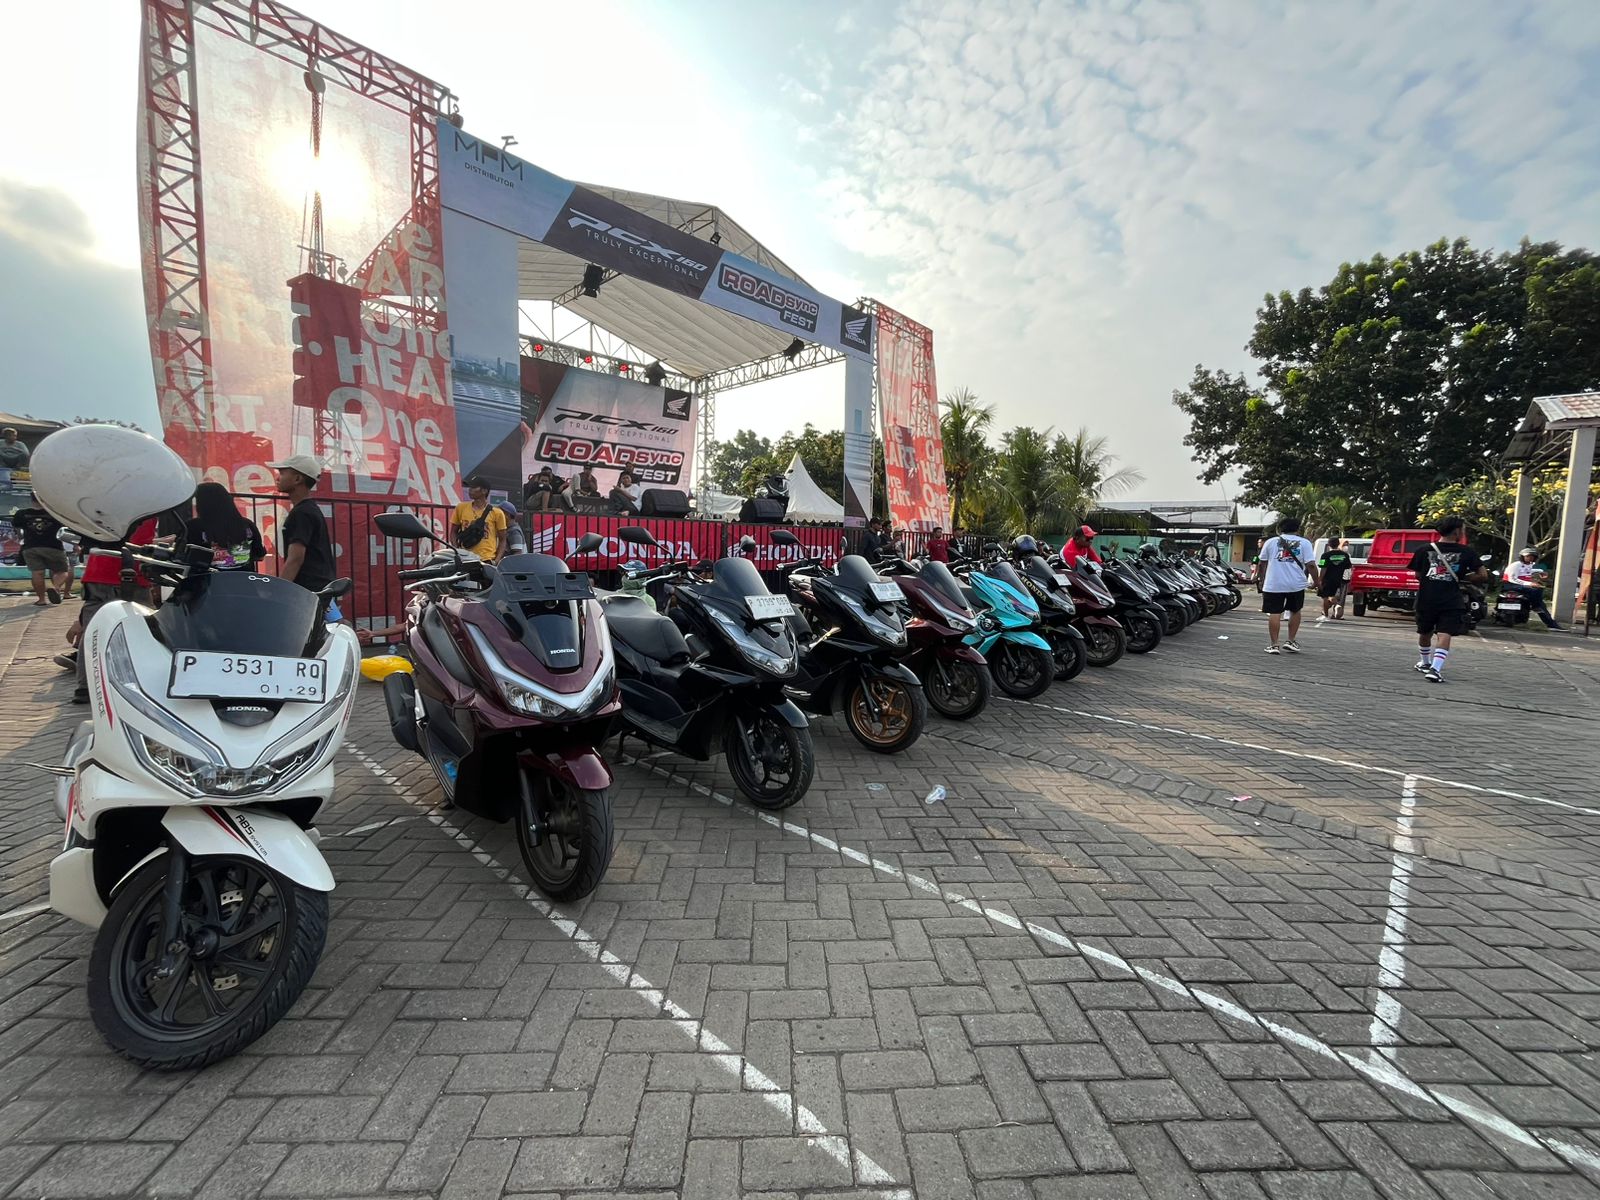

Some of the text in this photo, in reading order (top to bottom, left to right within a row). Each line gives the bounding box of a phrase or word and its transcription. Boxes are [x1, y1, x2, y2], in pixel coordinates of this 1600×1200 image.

[464, 162, 514, 188] DISTRIBUTOR
[585, 229, 699, 280] TRULY EXCEPTIONAL
[783, 311, 814, 329] FEST
[845, 334, 866, 346] HONDA
[327, 387, 443, 456] One
[666, 408, 686, 417] HONDA
[570, 421, 671, 443] TRULY EXCEPTIONAL
[1020, 576, 1047, 602] HONDA
[183, 655, 197, 672] P
[221, 657, 273, 676] 3531
[226, 705, 269, 713] HONDA
[235, 814, 256, 836] ABS
